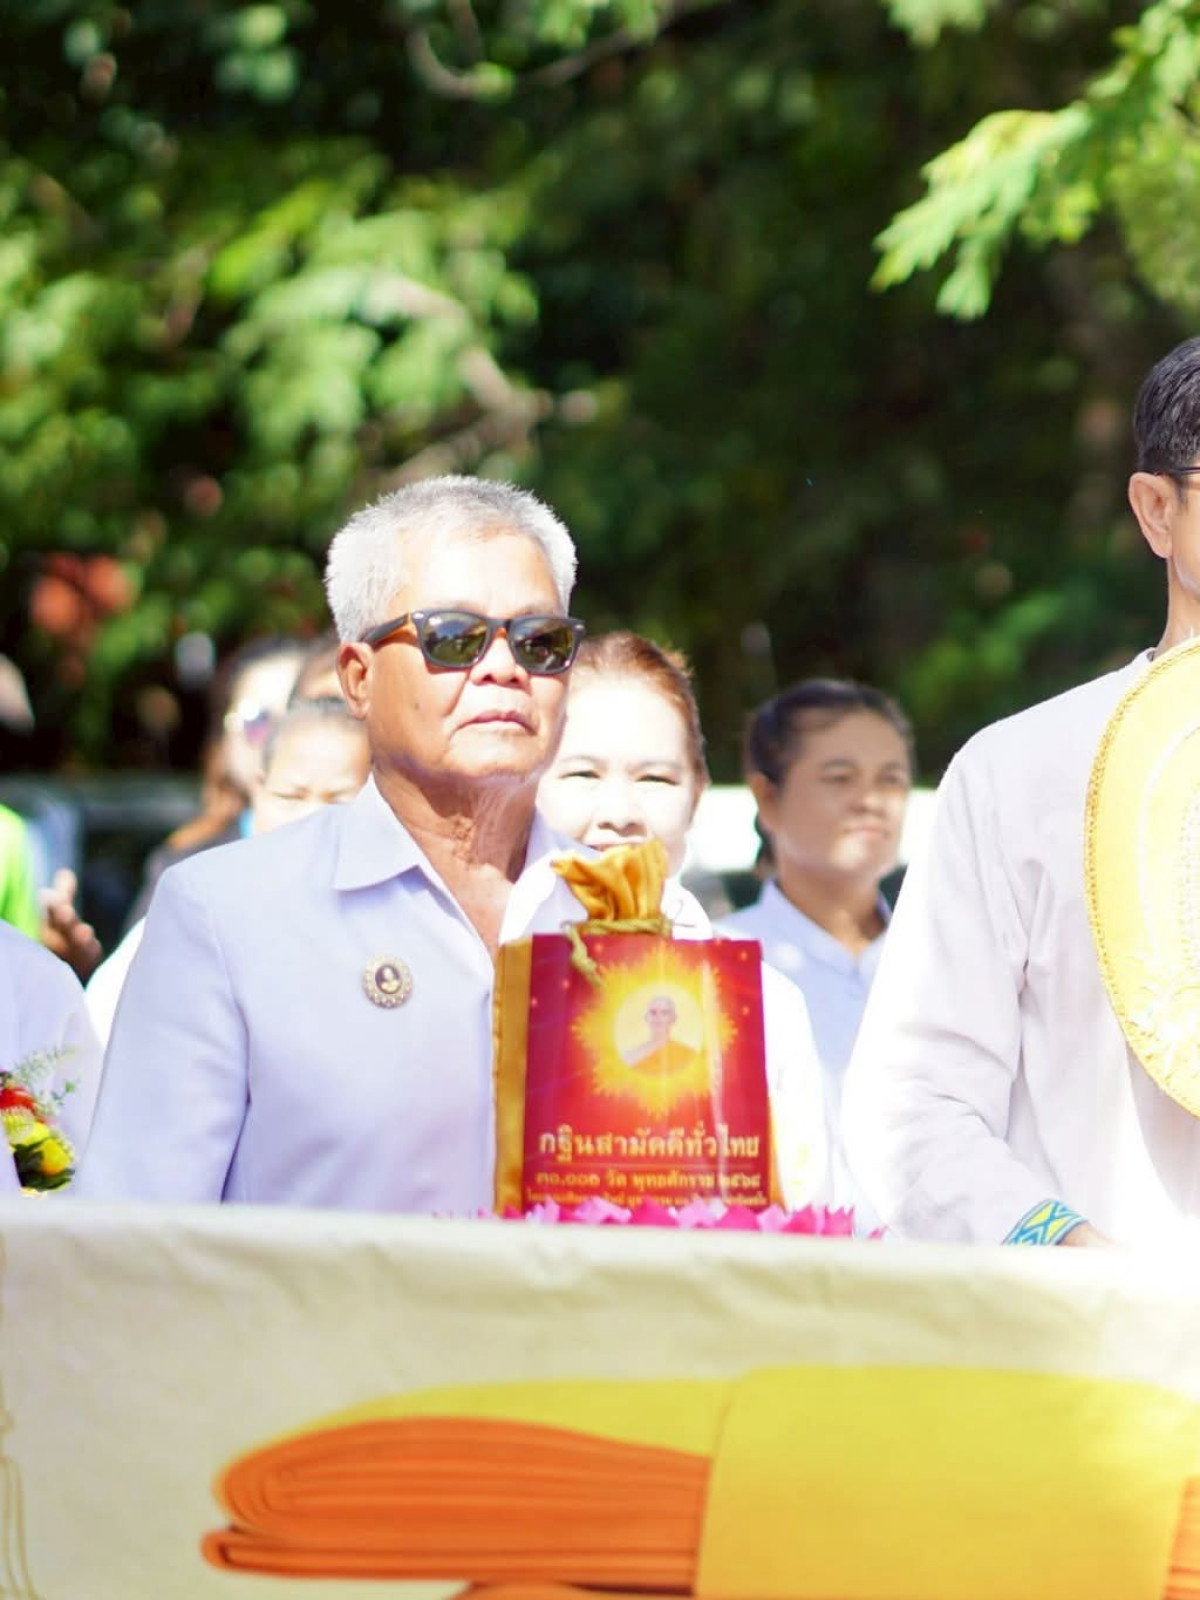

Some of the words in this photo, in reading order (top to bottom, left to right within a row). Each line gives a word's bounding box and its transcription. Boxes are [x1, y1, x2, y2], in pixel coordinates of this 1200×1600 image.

[538, 1120, 760, 1163] กฐินสามัคคีทั่วไทย
